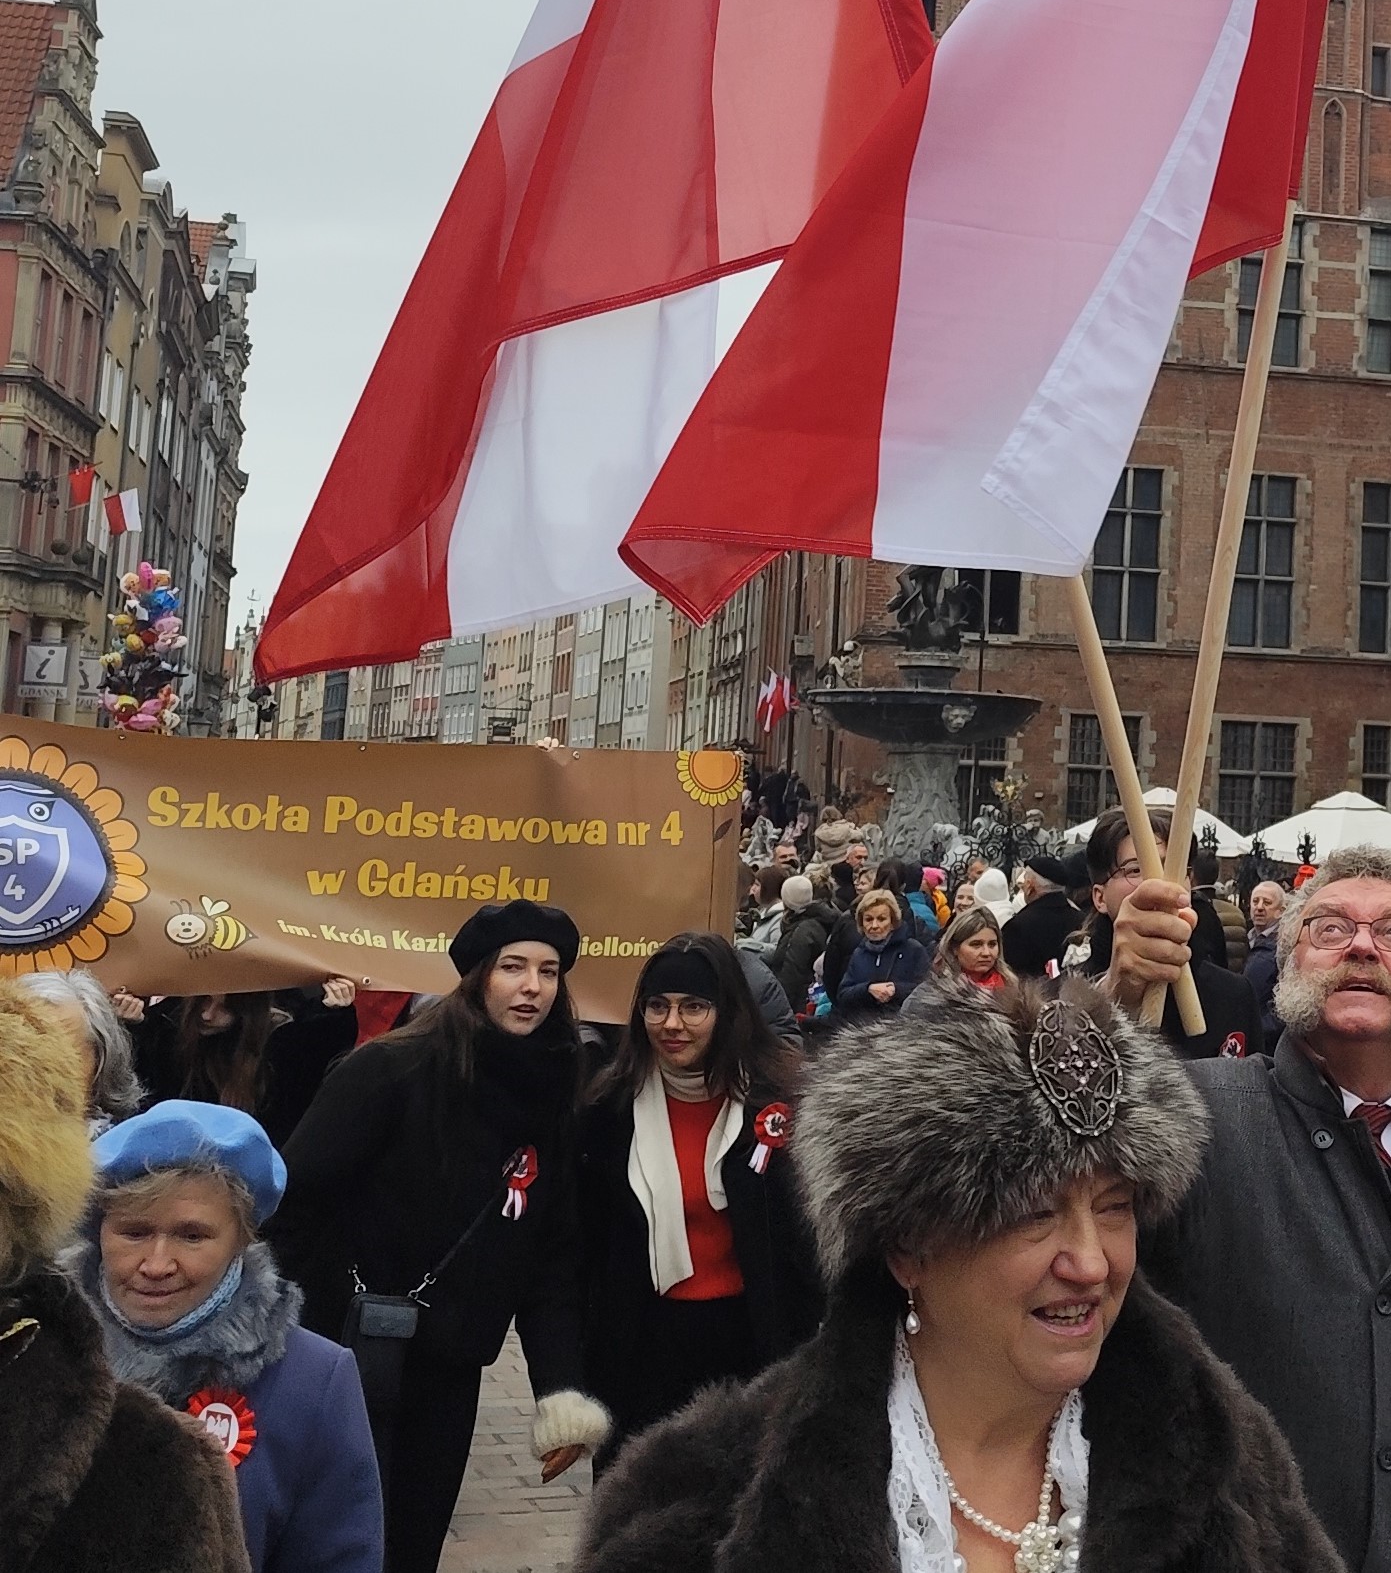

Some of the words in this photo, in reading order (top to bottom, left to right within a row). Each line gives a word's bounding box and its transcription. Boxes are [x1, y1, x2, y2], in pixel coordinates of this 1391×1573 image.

[147, 785, 310, 833] Szkoła
[323, 795, 608, 846] Podstawowa
[617, 821, 651, 846] nr
[660, 810, 684, 846] 4
[3, 874, 26, 901] 4
[306, 869, 347, 896] w
[357, 858, 550, 902] Gdańsku
[276, 919, 318, 939] im.
[319, 924, 388, 949] Króla
